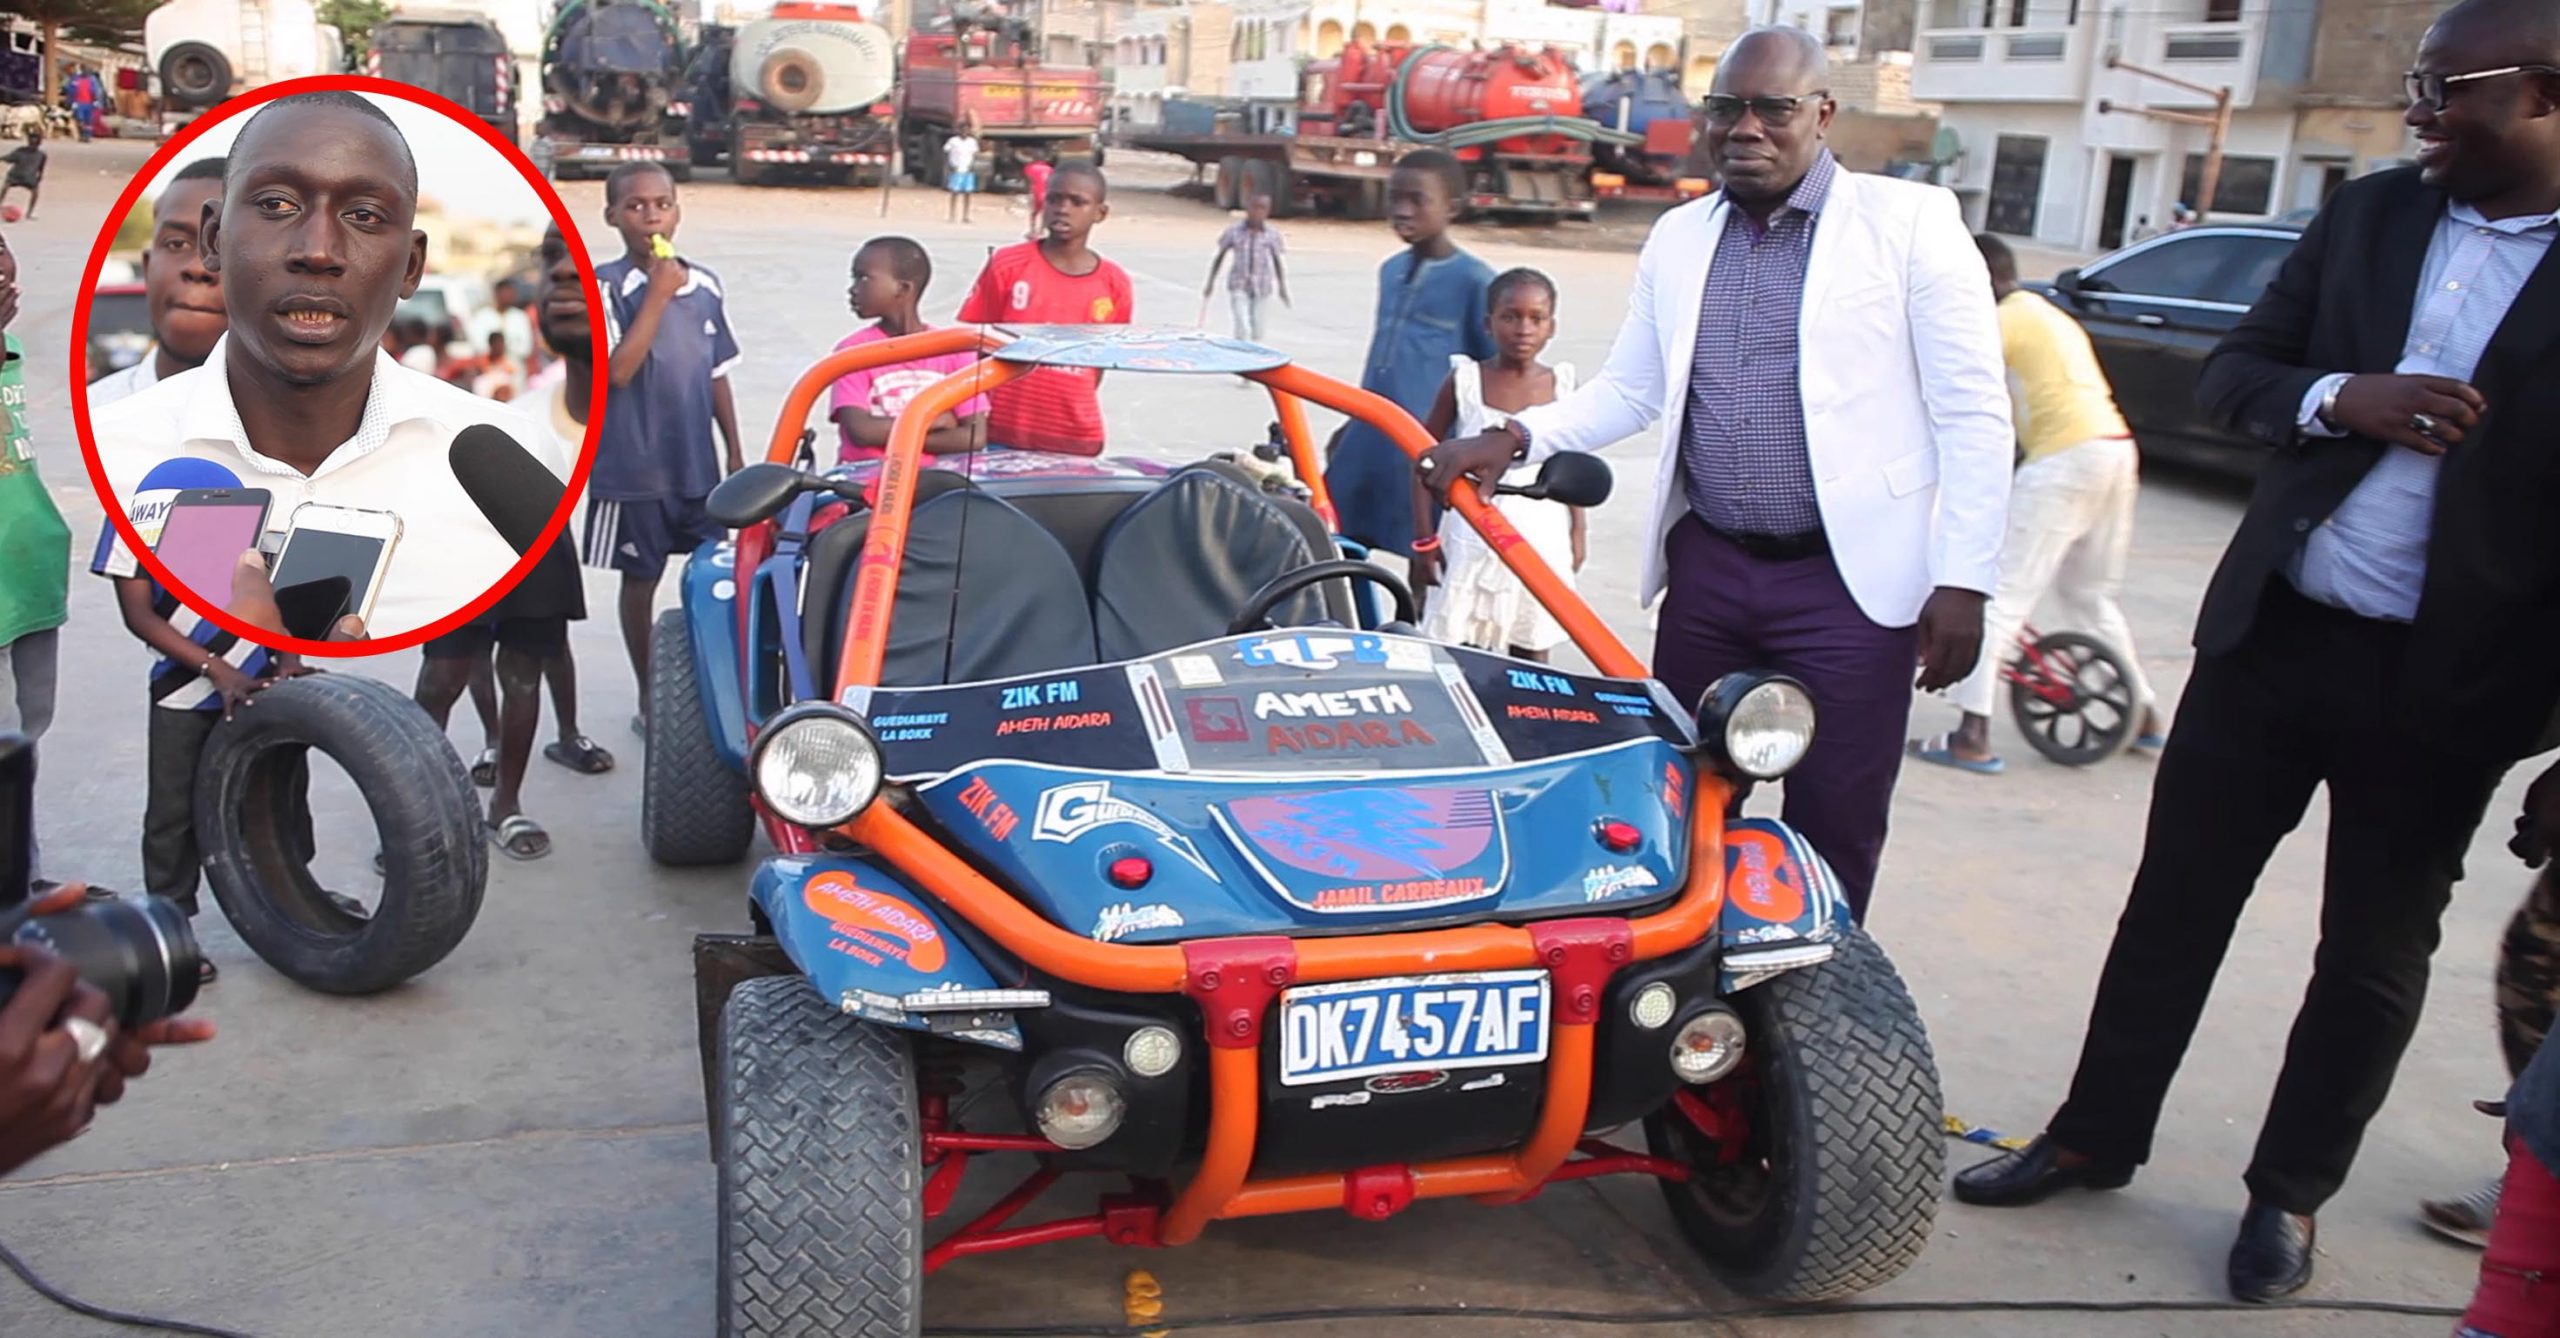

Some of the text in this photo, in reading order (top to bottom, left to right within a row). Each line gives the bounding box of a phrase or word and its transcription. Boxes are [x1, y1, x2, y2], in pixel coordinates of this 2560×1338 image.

[1012, 281, 1030, 310] 9
[1002, 681, 1079, 709] ZIK FM
[1506, 669, 1575, 696] ZIK FM
[1254, 684, 1412, 719] AMETH
[873, 713, 948, 727] GUEDIAWAYE
[996, 712, 1111, 736] AMETH AIDARA
[881, 730, 896, 741] LA
[958, 775, 1019, 841] ZIK FM
[813, 882, 878, 910] AMETH
[1312, 878, 1484, 909] JAMIL CARREAUX
